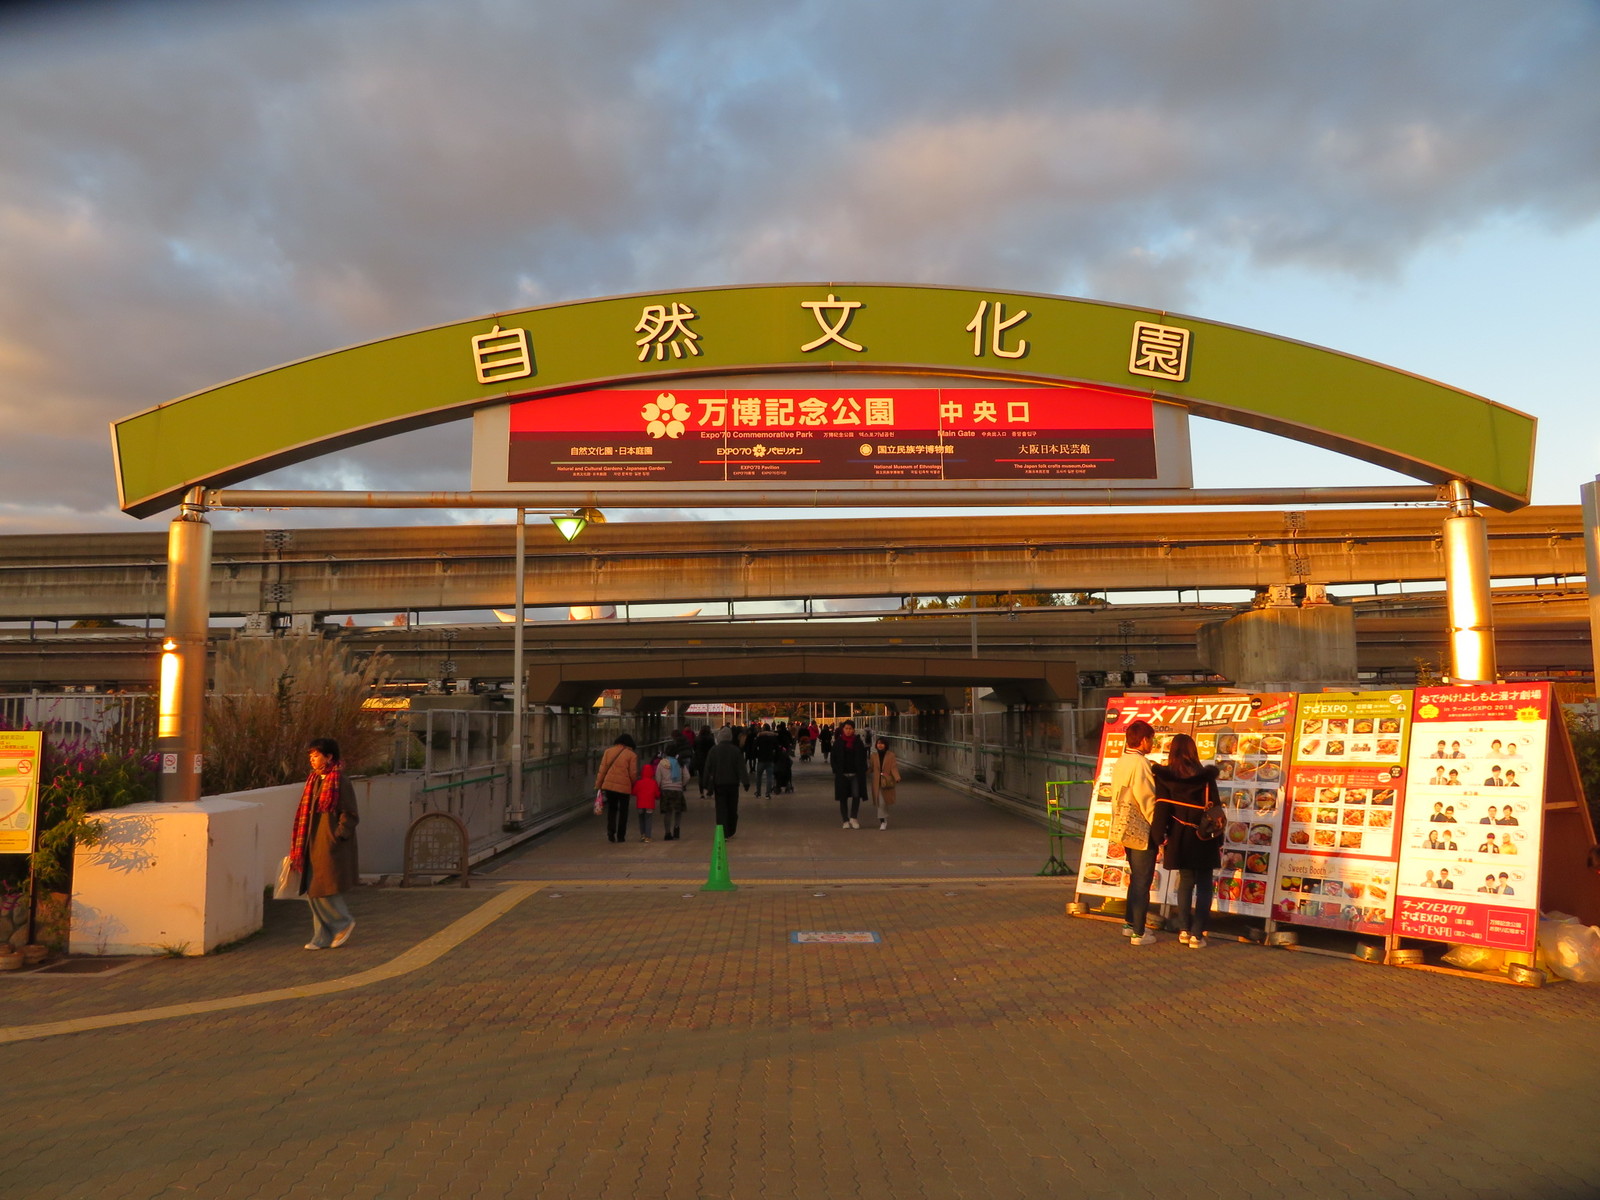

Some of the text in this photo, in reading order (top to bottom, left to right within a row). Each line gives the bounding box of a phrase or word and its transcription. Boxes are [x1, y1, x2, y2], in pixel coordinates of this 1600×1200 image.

[471, 293, 1190, 384] 自然文化園
[698, 397, 1030, 427] 万博記念公園 中央口
[766, 447, 803, 455] パビリオン
[877, 445, 954, 454] 国立民族学博物館
[1018, 444, 1091, 455] 大阪日本民芸館
[1121, 703, 1253, 724] ラーメンEXPO
[1288, 864, 1308, 875] Sweets
[1309, 865, 1327, 876] Booth
[1401, 900, 1467, 915] ラーメンEXPO
[1401, 910, 1448, 925] さばEXPO
